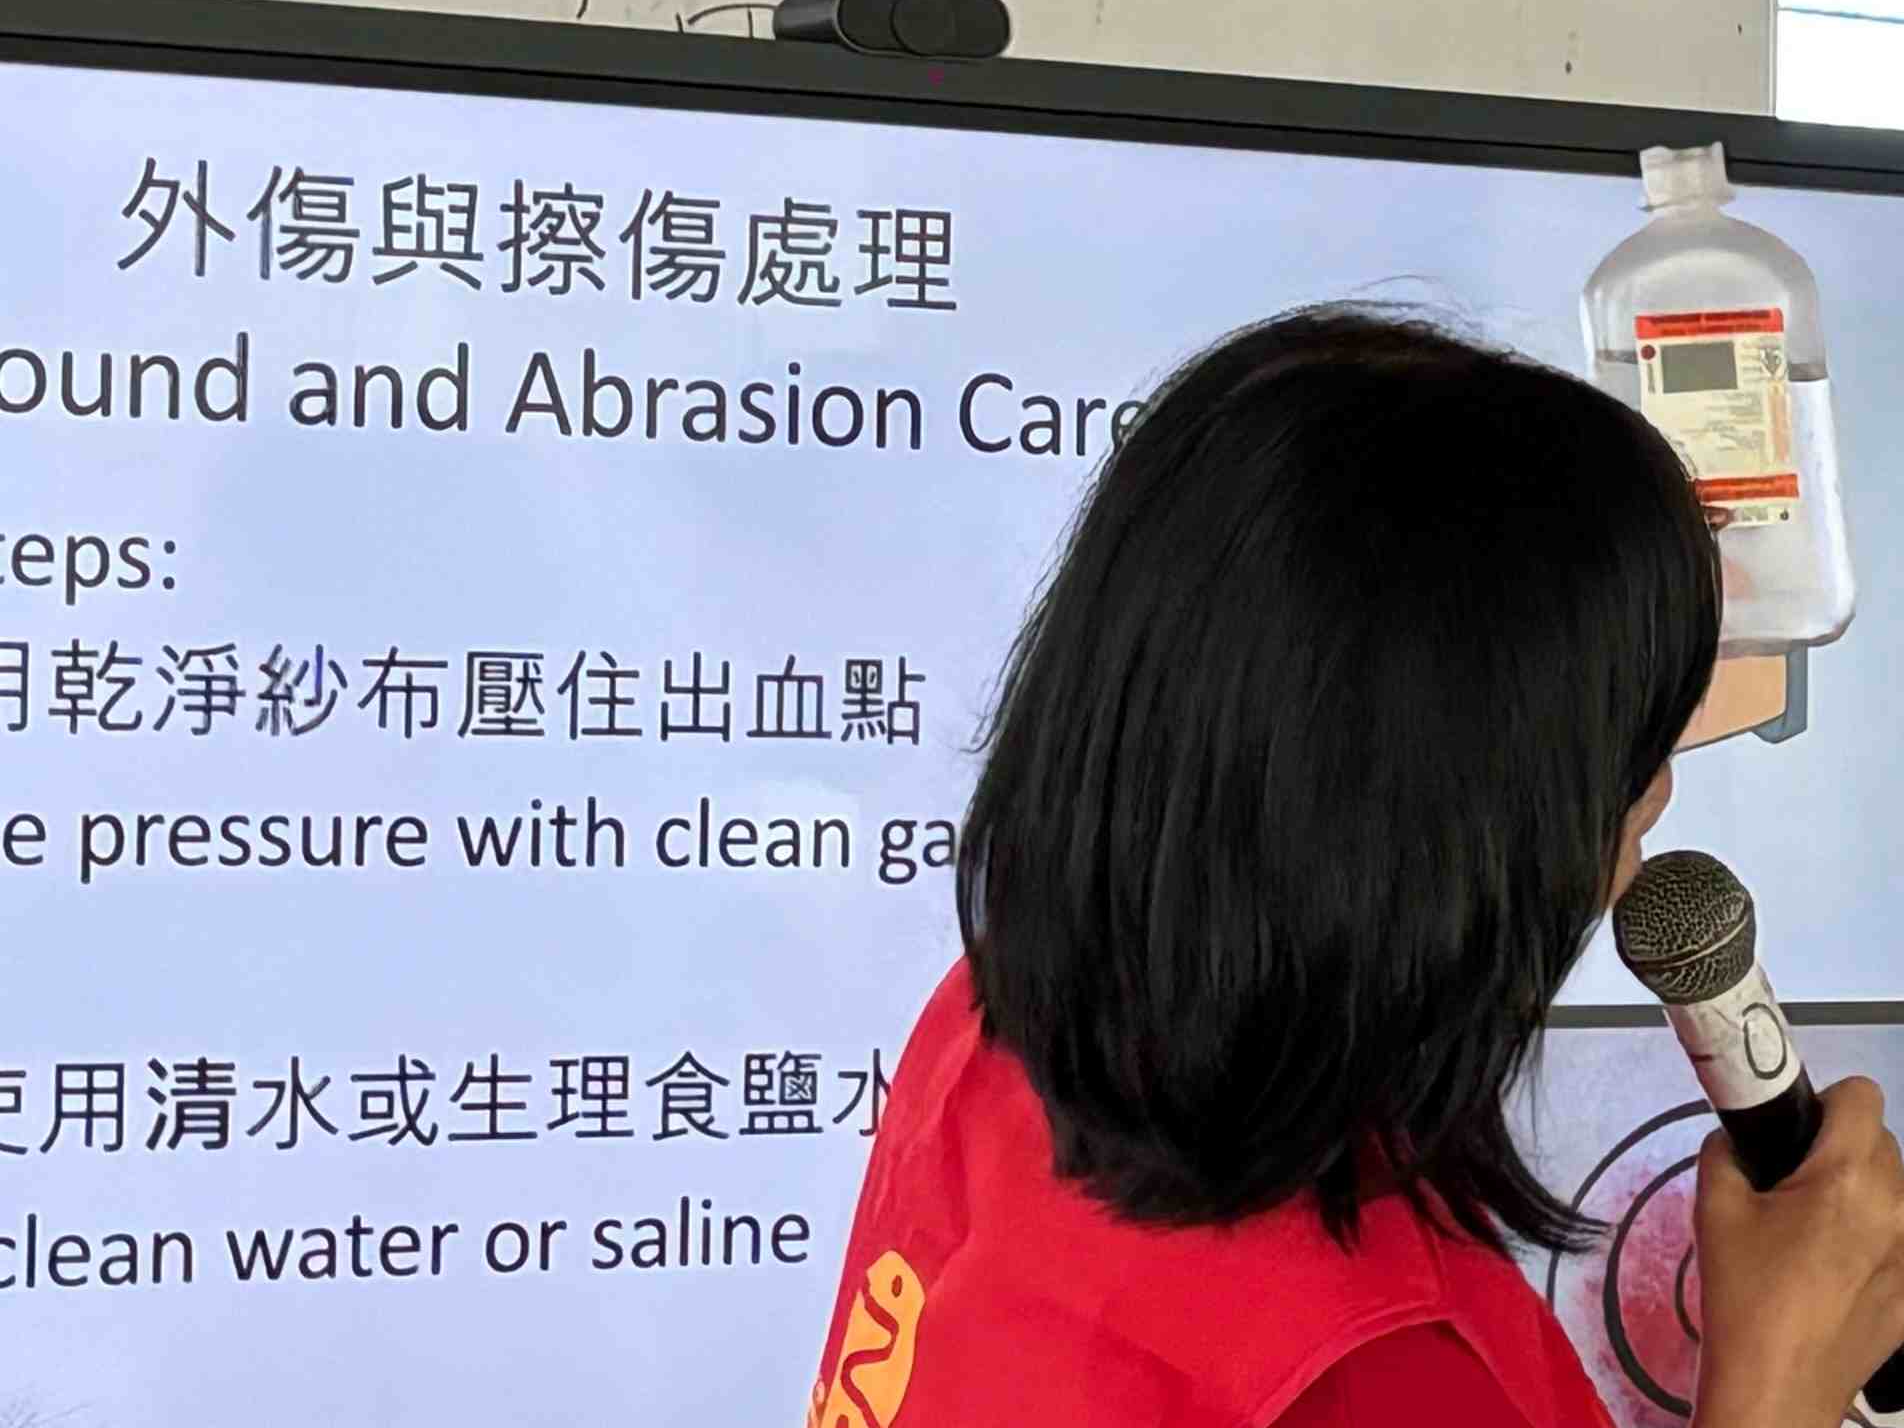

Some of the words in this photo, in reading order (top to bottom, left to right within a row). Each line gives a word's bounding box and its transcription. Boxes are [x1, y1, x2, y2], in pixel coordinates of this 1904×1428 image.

[117, 157, 957, 312] 外傷與擦傷處理
[289, 342, 469, 431] and
[505, 348, 922, 450] Abrasion
[0, 534, 176, 606] eps:
[80, 814, 428, 885] pressure
[457, 796, 625, 868] with
[655, 797, 850, 868] clean
[878, 819, 957, 884] ga
[226, 1215, 459, 1281] water
[485, 1220, 567, 1273] or
[592, 1195, 810, 1270] saline
